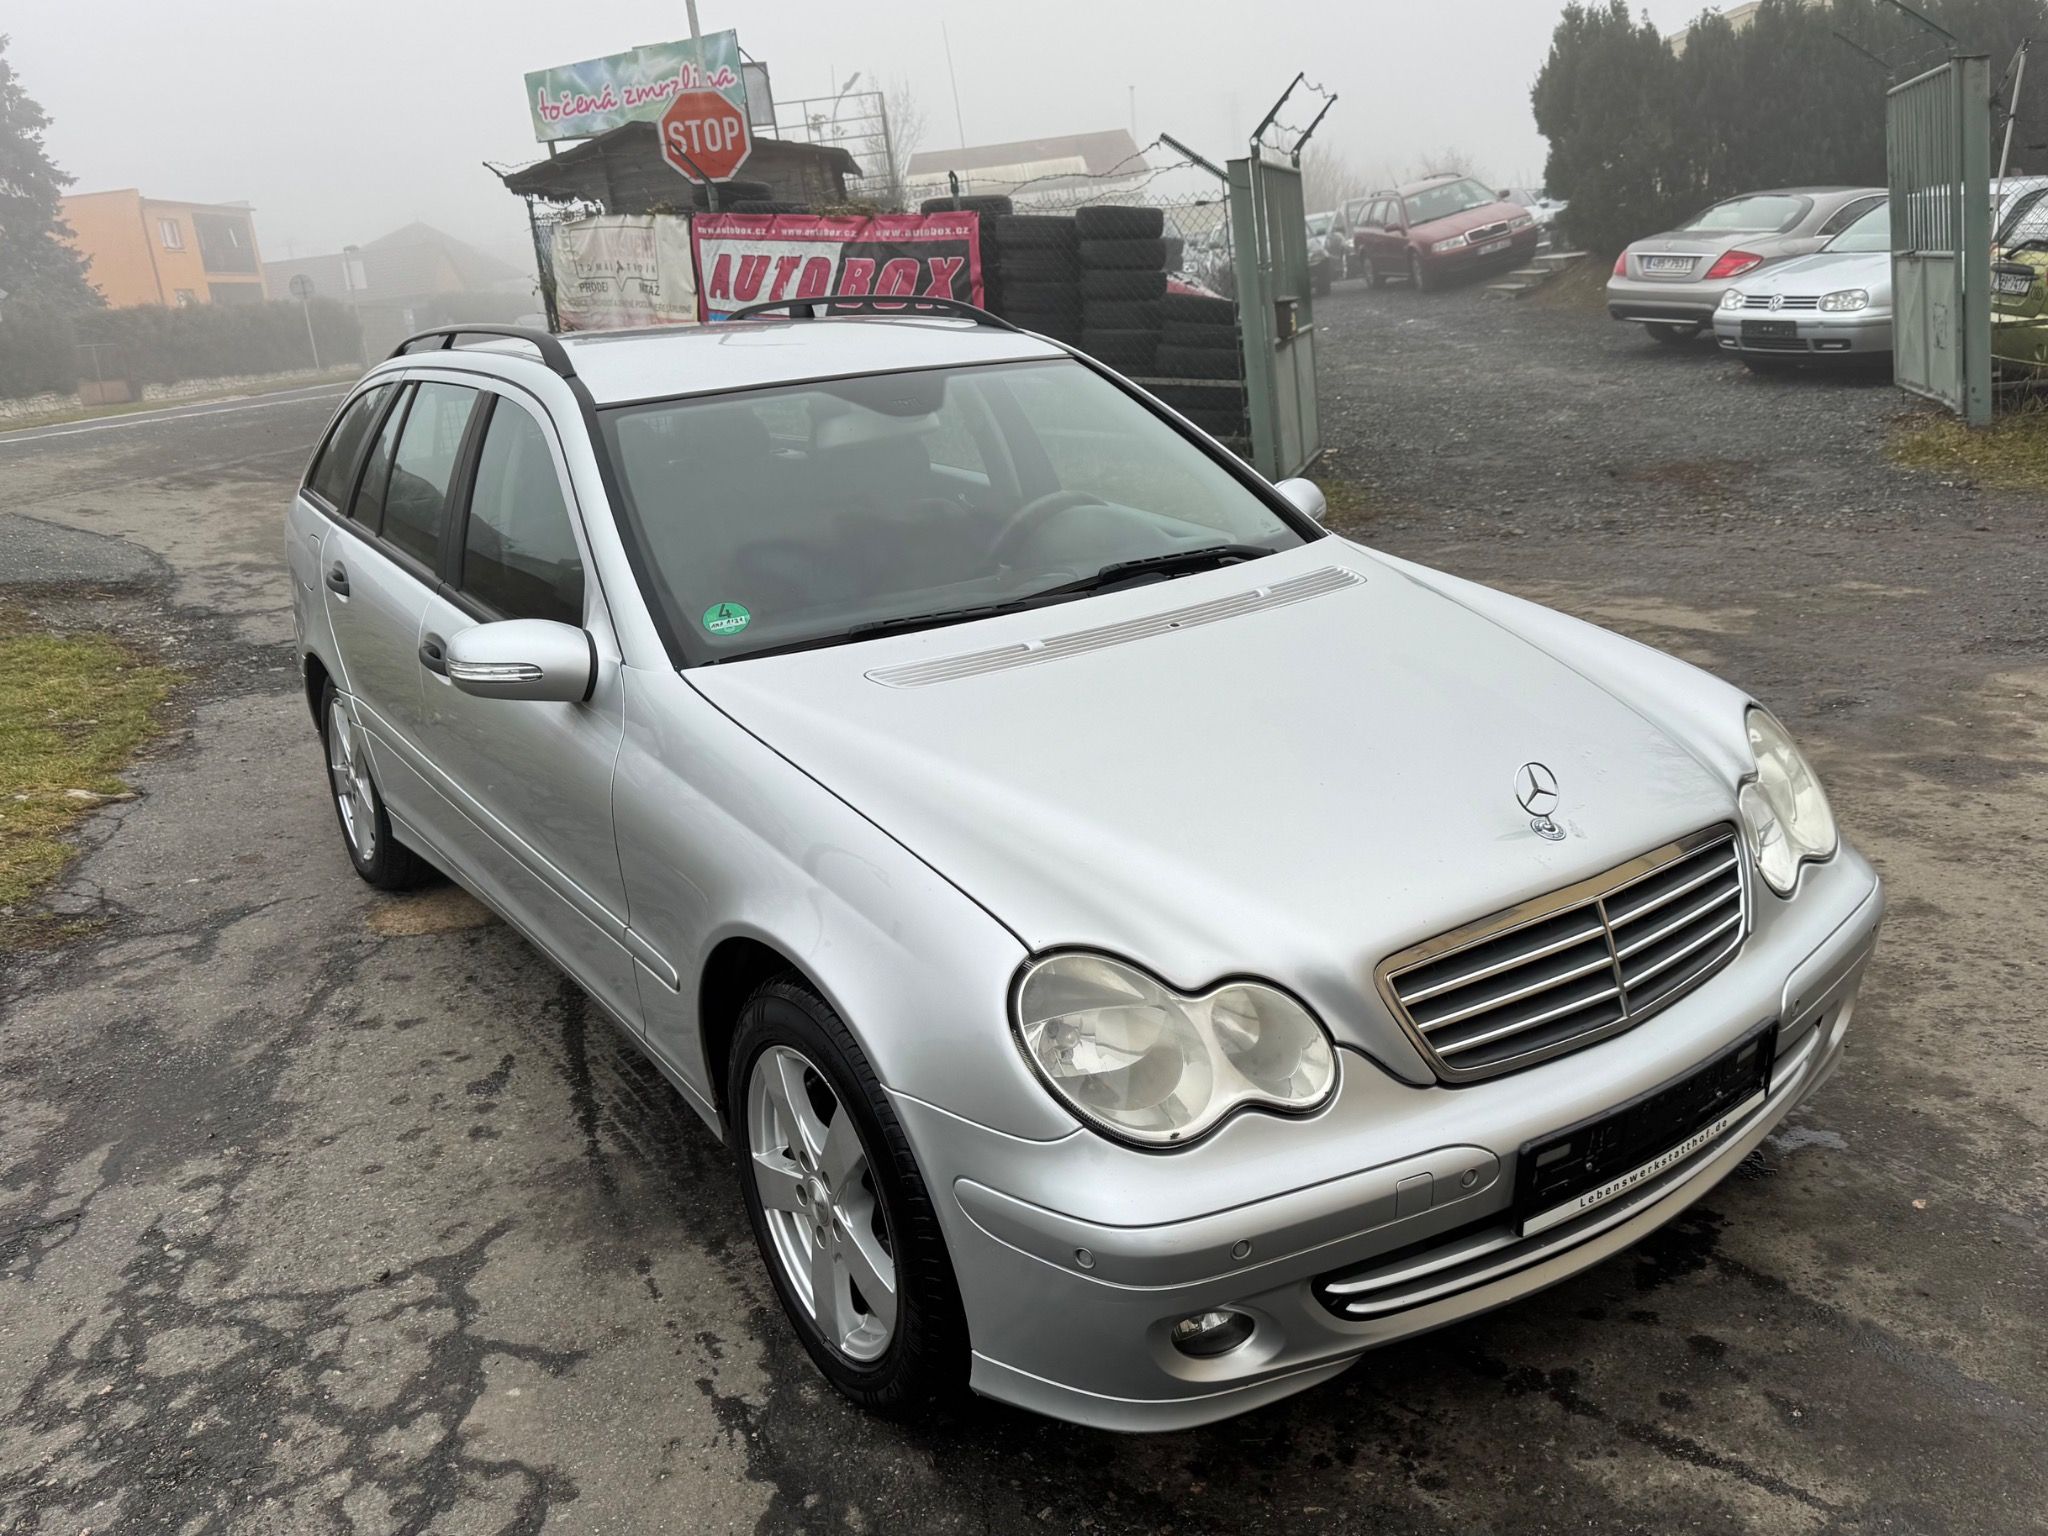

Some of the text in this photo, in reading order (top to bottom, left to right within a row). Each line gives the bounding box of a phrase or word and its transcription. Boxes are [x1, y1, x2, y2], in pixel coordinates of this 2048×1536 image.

[538, 84, 618, 121] točená
[667, 116, 740, 155] STOP
[875, 226, 970, 237] www.autobox.cz
[709, 253, 965, 310] AUTOBOX
[719, 604, 732, 618] 4
[1579, 1119, 1728, 1208] Lebenswerkstatthof.de
